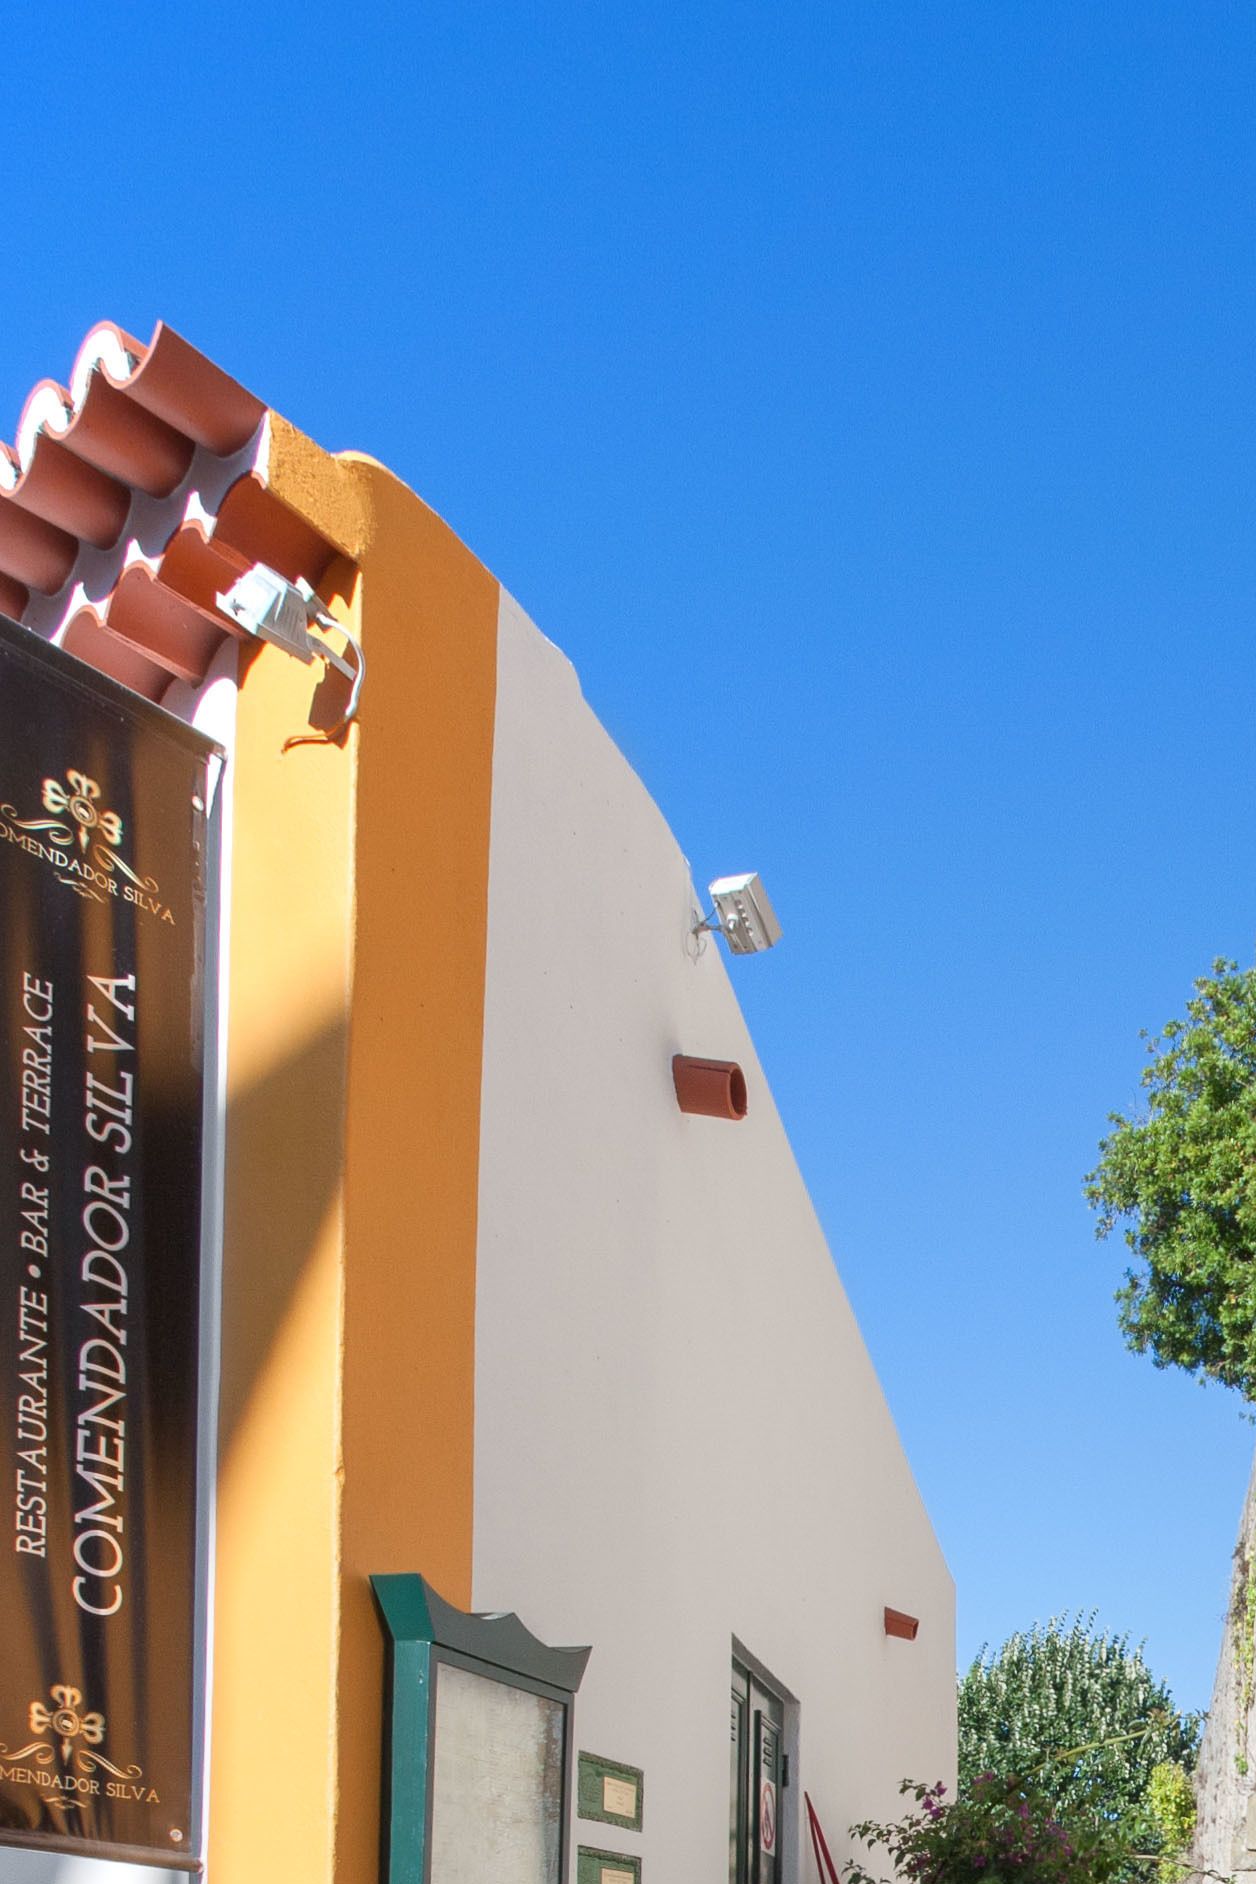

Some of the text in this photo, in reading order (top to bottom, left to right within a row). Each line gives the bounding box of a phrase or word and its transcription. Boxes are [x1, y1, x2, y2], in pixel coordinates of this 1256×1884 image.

[123, 885, 176, 926] SILVA
[14, 971, 53, 1558] RESTAURANTE BAR & TERRACE
[71, 973, 136, 1616] COMENDADOR SILVA
[105, 1782, 161, 1803] SILVA
